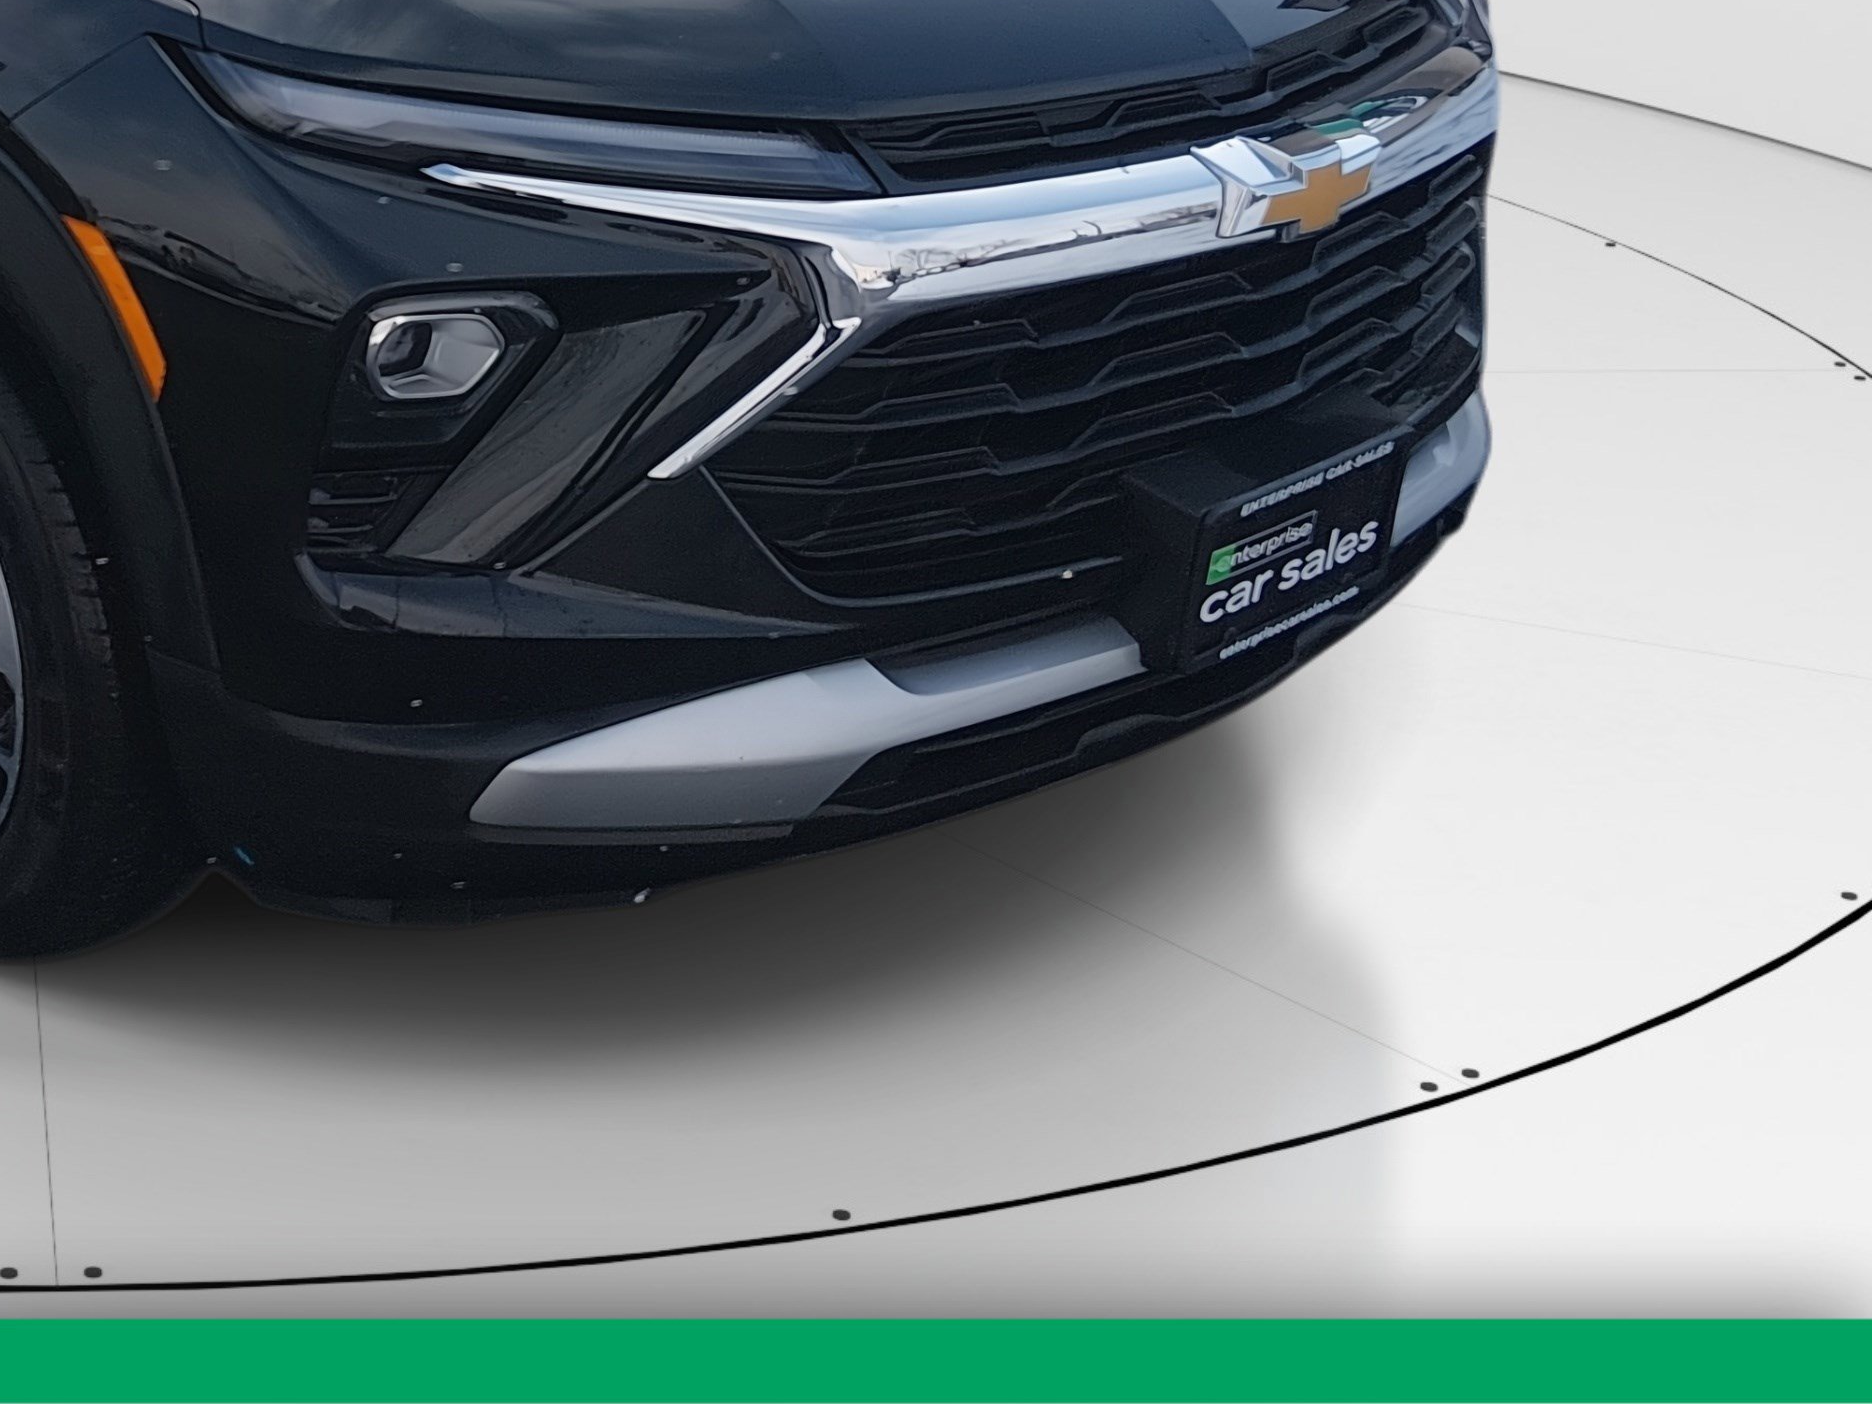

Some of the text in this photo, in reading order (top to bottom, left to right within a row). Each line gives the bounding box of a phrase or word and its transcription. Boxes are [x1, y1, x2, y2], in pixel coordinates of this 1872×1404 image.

[1240, 471, 1324, 517] ENTERPRISE
[1199, 521, 1379, 623] car sales
[1210, 521, 1313, 573] enterprise
